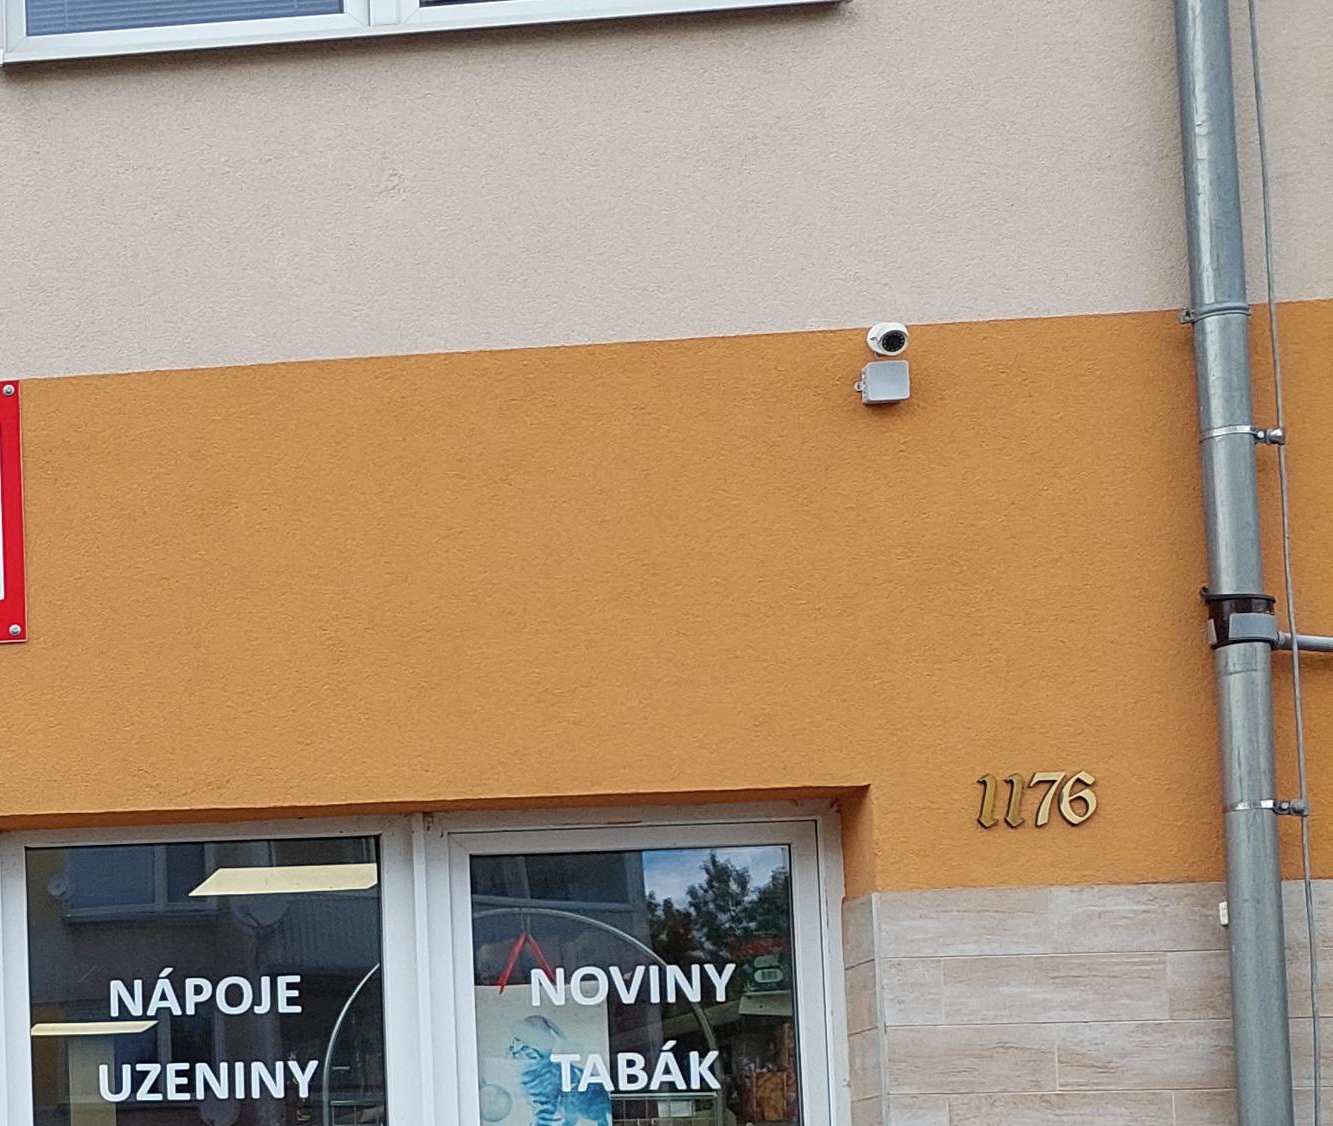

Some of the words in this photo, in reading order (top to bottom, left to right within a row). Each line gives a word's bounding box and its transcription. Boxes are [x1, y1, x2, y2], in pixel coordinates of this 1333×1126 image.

[976, 770, 1098, 828] 1176
[110, 967, 302, 1017] NÁPOJE
[530, 963, 736, 1007] NOVINY
[98, 1059, 320, 1103] UZENINY
[551, 1040, 722, 1093] TABÁK
